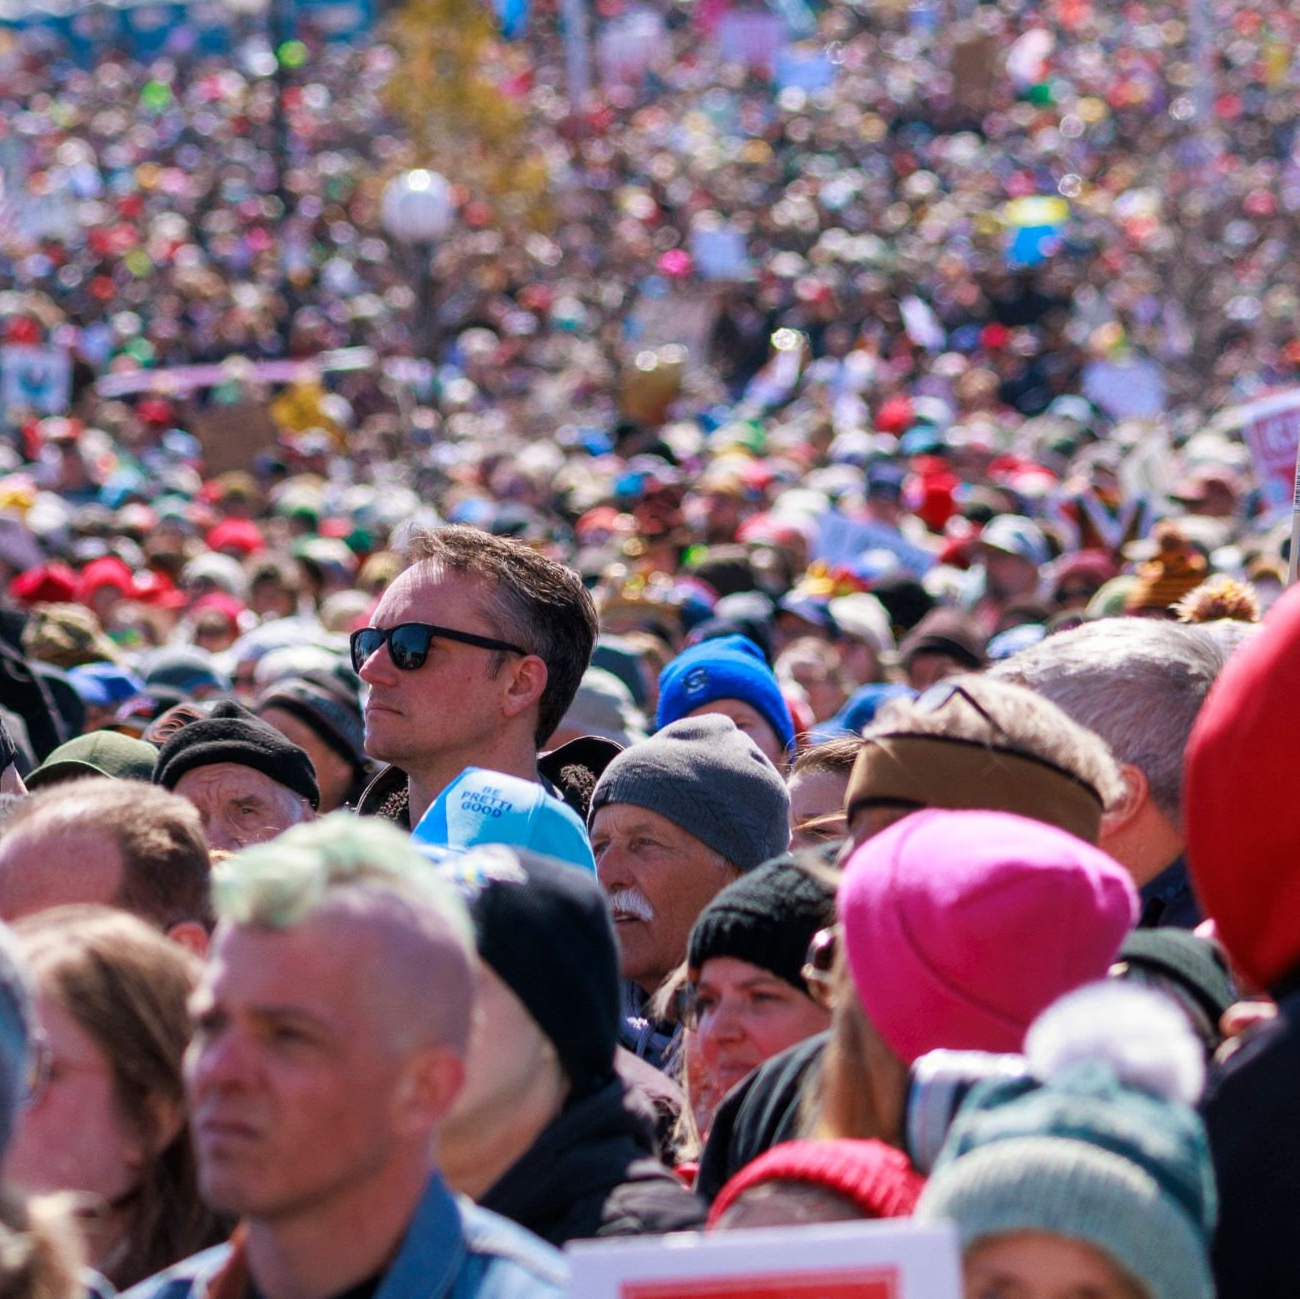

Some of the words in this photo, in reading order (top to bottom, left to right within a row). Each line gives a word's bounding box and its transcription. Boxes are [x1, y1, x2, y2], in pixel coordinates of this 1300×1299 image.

[482, 786, 502, 797] BE
[460, 791, 514, 813] PRETTI
[460, 801, 503, 819] GOOD
